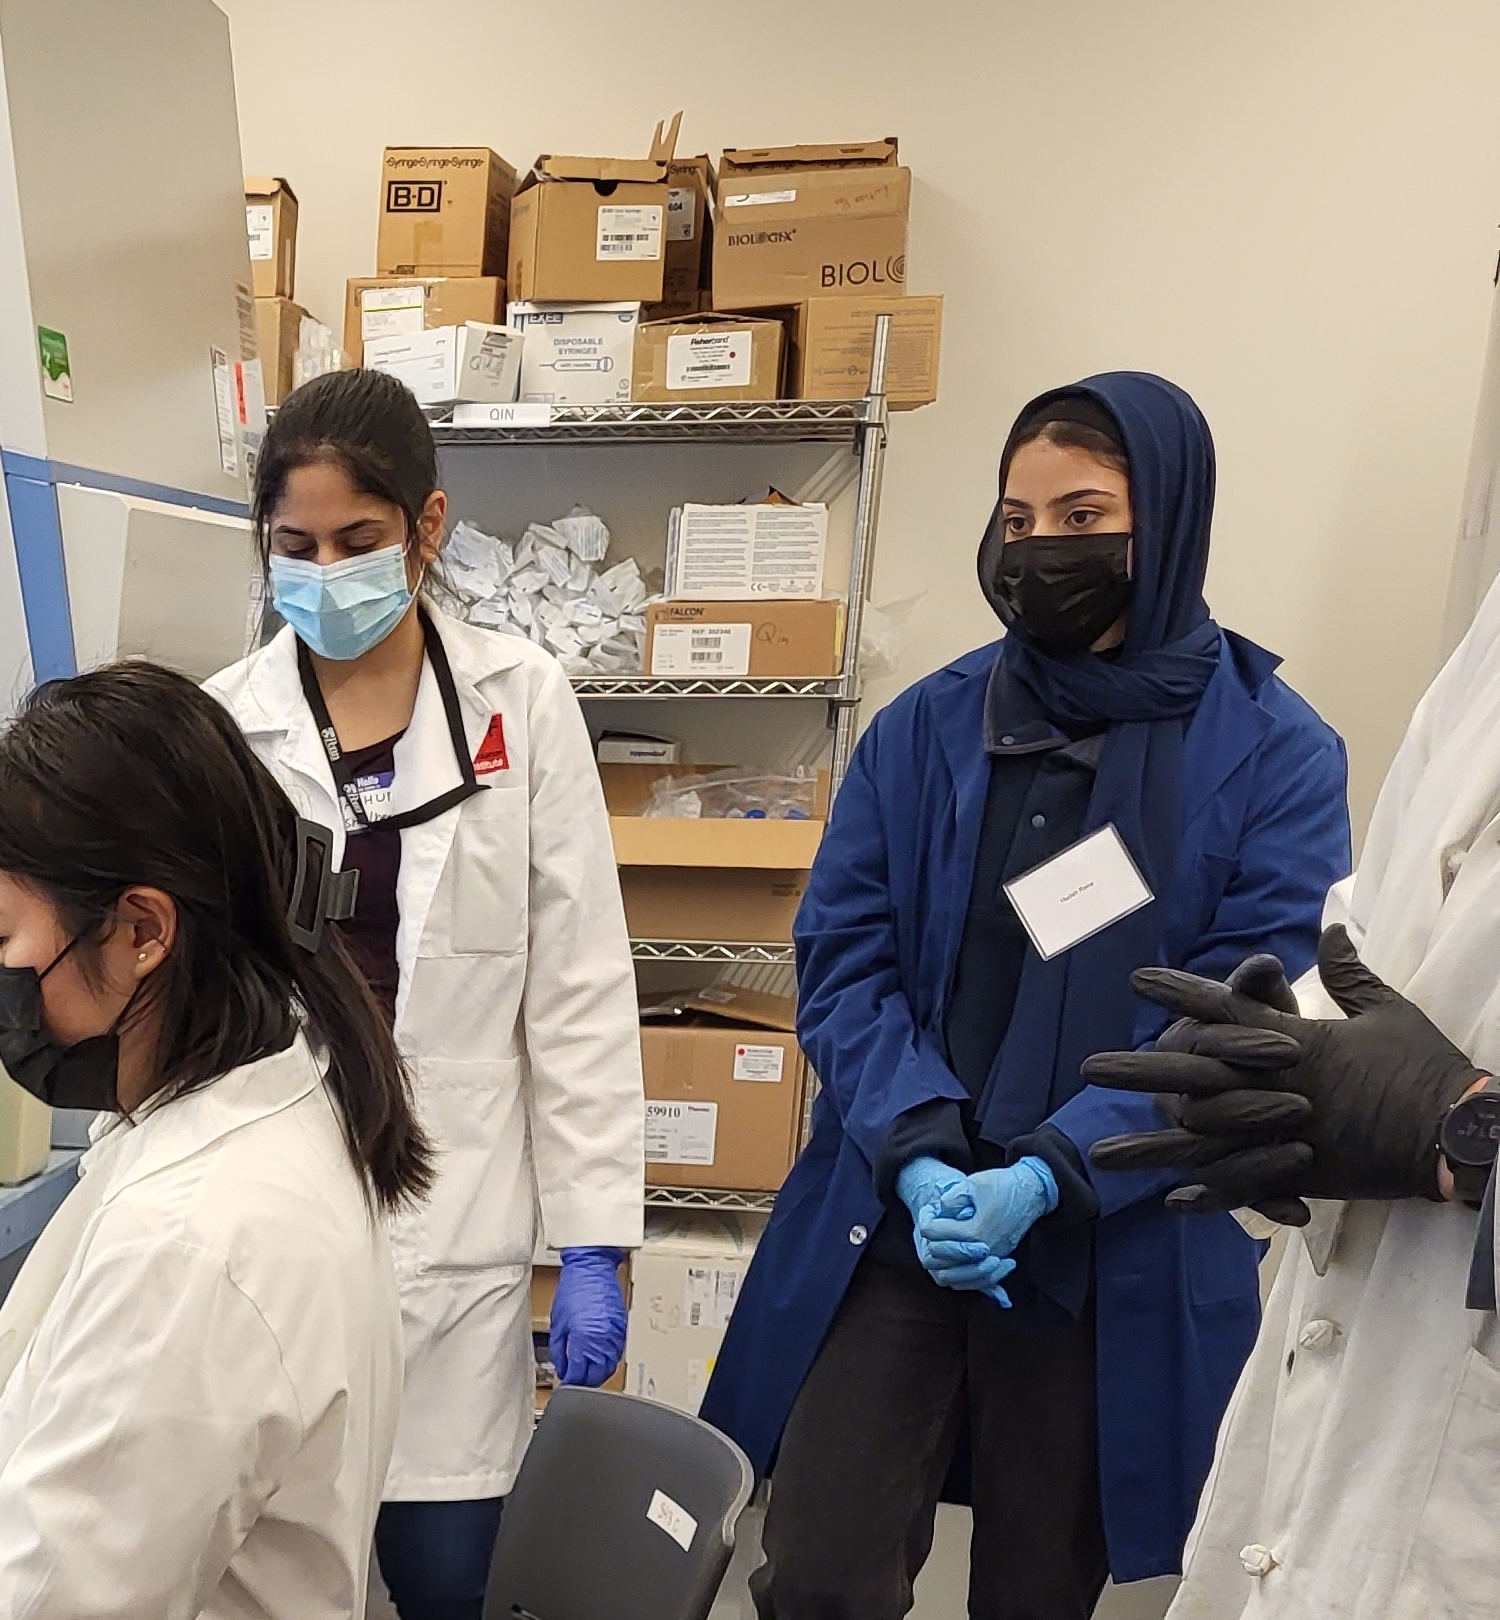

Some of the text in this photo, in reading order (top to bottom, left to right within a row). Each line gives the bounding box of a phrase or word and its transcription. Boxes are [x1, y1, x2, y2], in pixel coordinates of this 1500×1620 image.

[553, 337, 604, 346] DISPOSABLE
[558, 347, 598, 355] SYRINGES
[489, 408, 515, 422] QIN
[670, 607, 704, 617] FALCON
